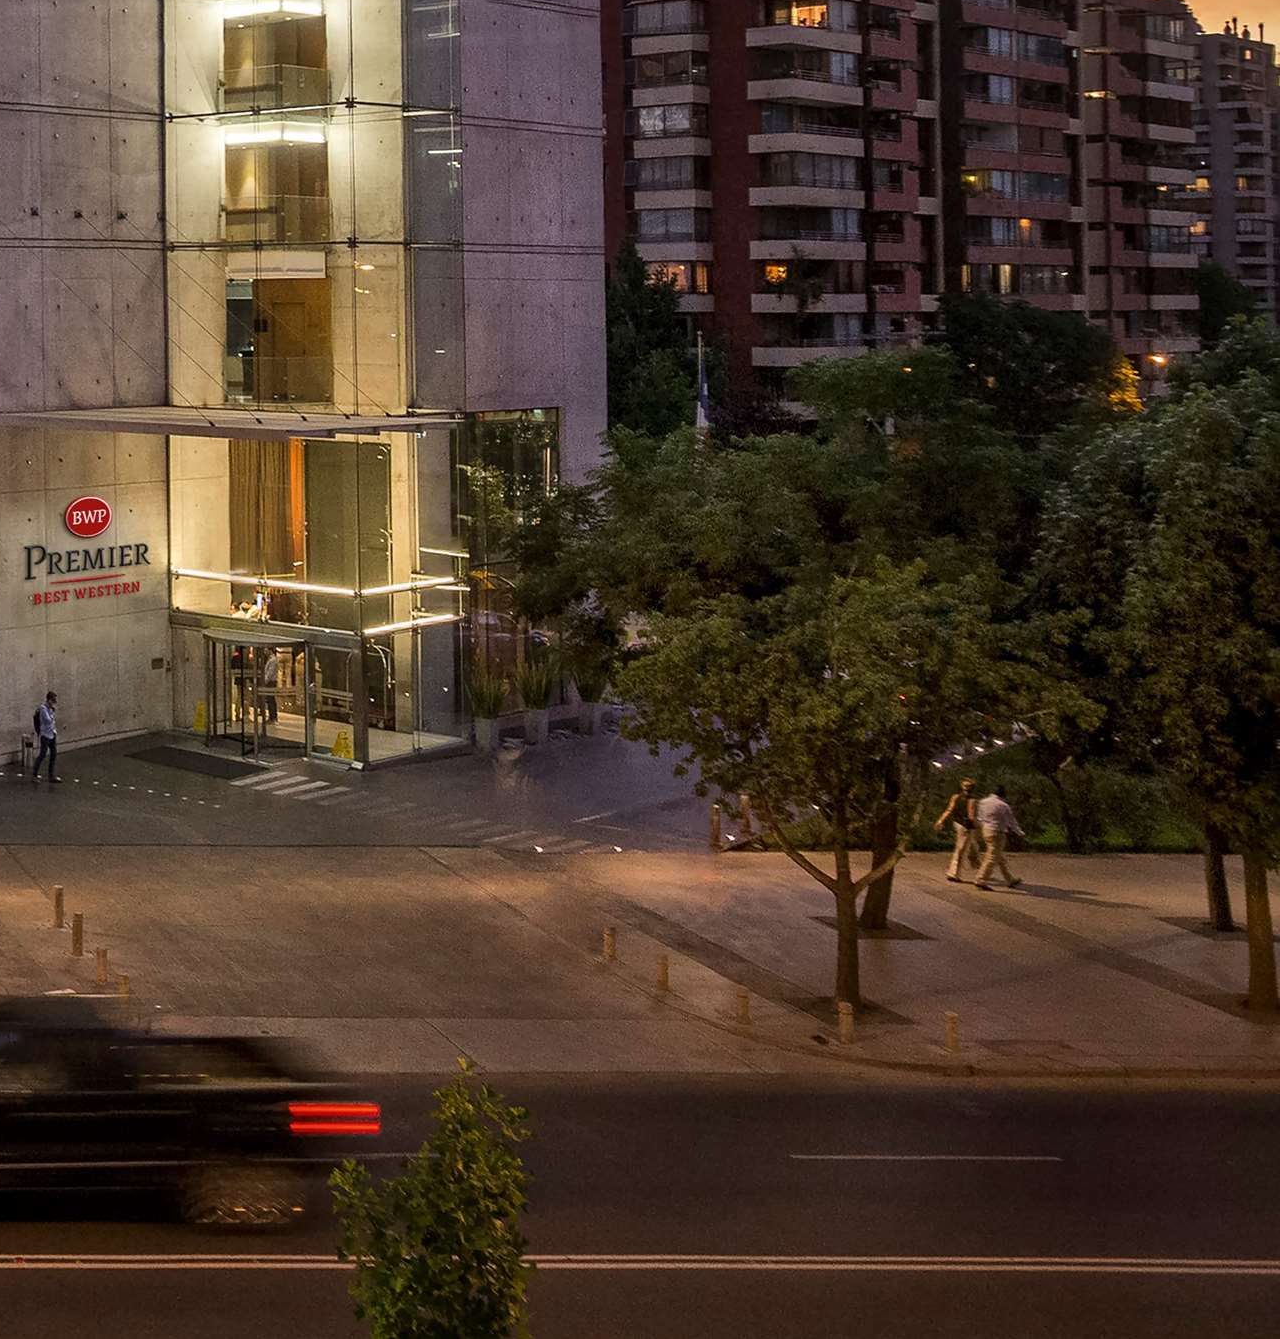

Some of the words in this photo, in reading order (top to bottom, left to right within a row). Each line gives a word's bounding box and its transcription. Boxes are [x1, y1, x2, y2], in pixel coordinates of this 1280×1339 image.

[72, 509, 107, 526] BWP
[23, 543, 151, 580] PREMIER
[33, 589, 70, 606] BEST
[73, 581, 141, 601] WESTERN
